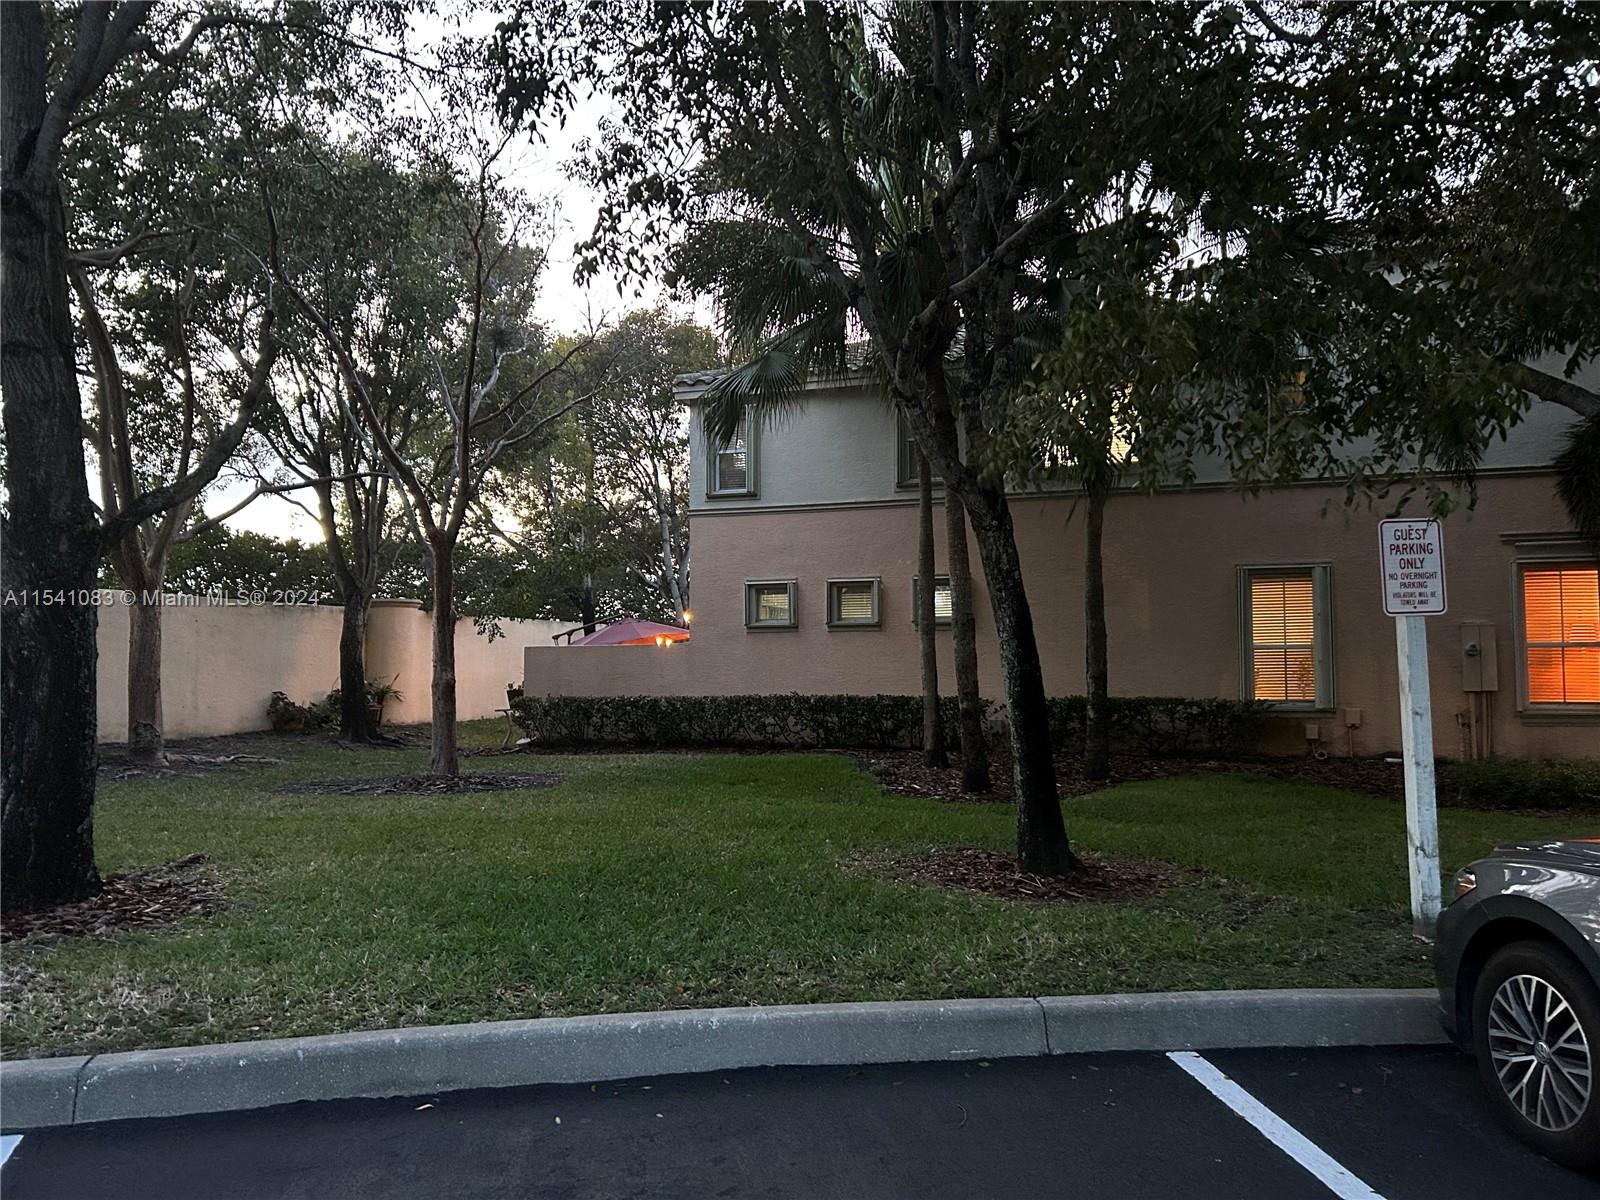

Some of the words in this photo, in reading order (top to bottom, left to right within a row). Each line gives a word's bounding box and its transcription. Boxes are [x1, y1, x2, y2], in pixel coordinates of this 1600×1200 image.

[1394, 529, 1427, 540] GUEST
[1389, 543, 1433, 555] PARKING
[1399, 558, 1425, 569] ONLY
[1388, 573, 1398, 581] NO
[1400, 571, 1438, 580] OVERNIGHT
[1399, 581, 1428, 589] PARKING
